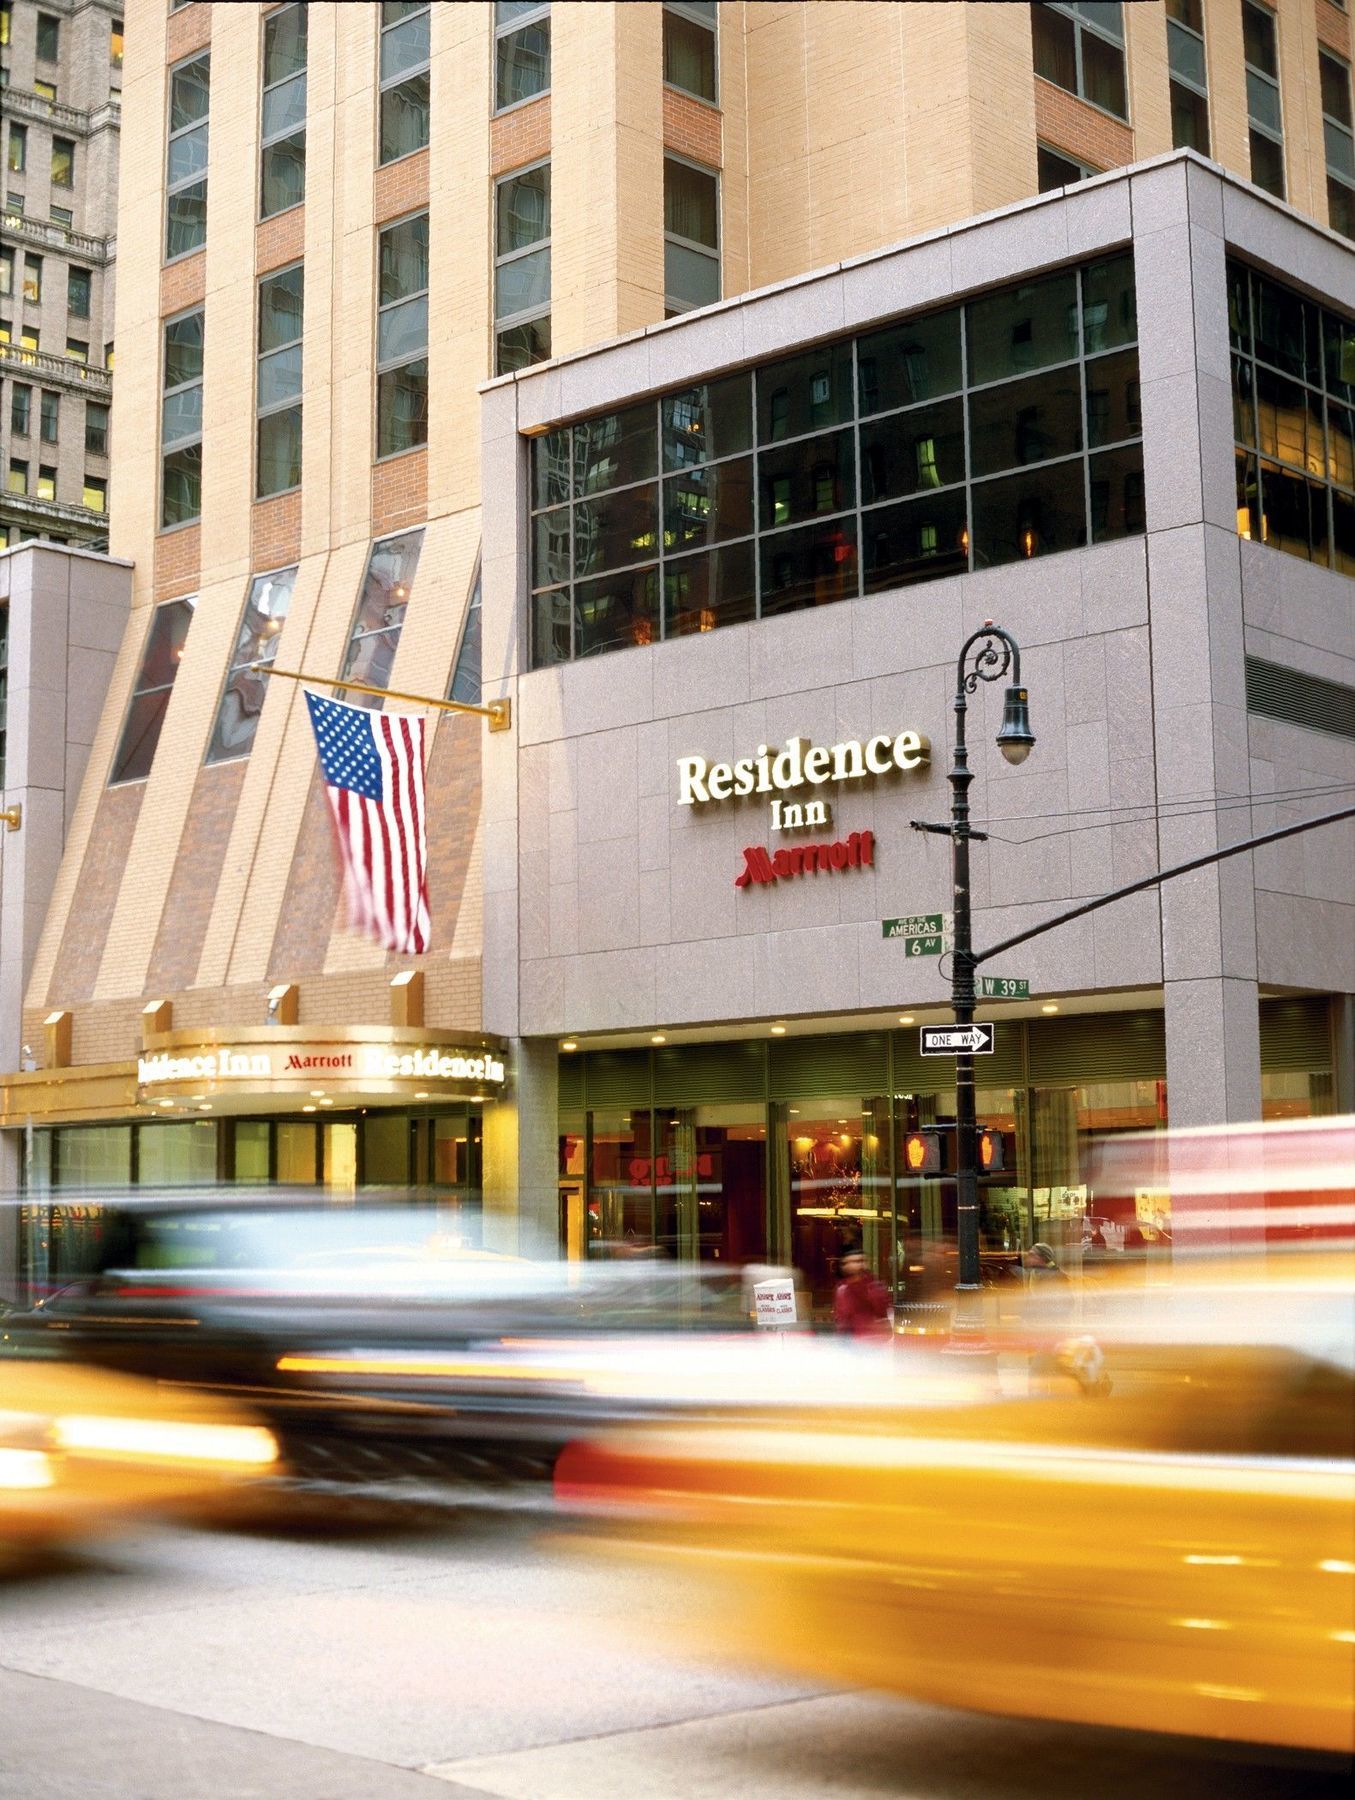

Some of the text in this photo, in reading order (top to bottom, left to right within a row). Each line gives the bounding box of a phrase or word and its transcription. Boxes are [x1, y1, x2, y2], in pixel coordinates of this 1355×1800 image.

[677, 730, 923, 806] Residence
[770, 799, 827, 830] Inn
[735, 831, 875, 888] Marriott
[889, 922, 937, 936] AMERICAS
[912, 938, 936, 956] 6 AV
[984, 978, 1028, 996] W 39 ST
[931, 1033, 982, 1046] ONE WAY
[218, 1049, 271, 1076] Inn
[284, 1054, 352, 1070] Marriott
[362, 1047, 484, 1080] Residence
